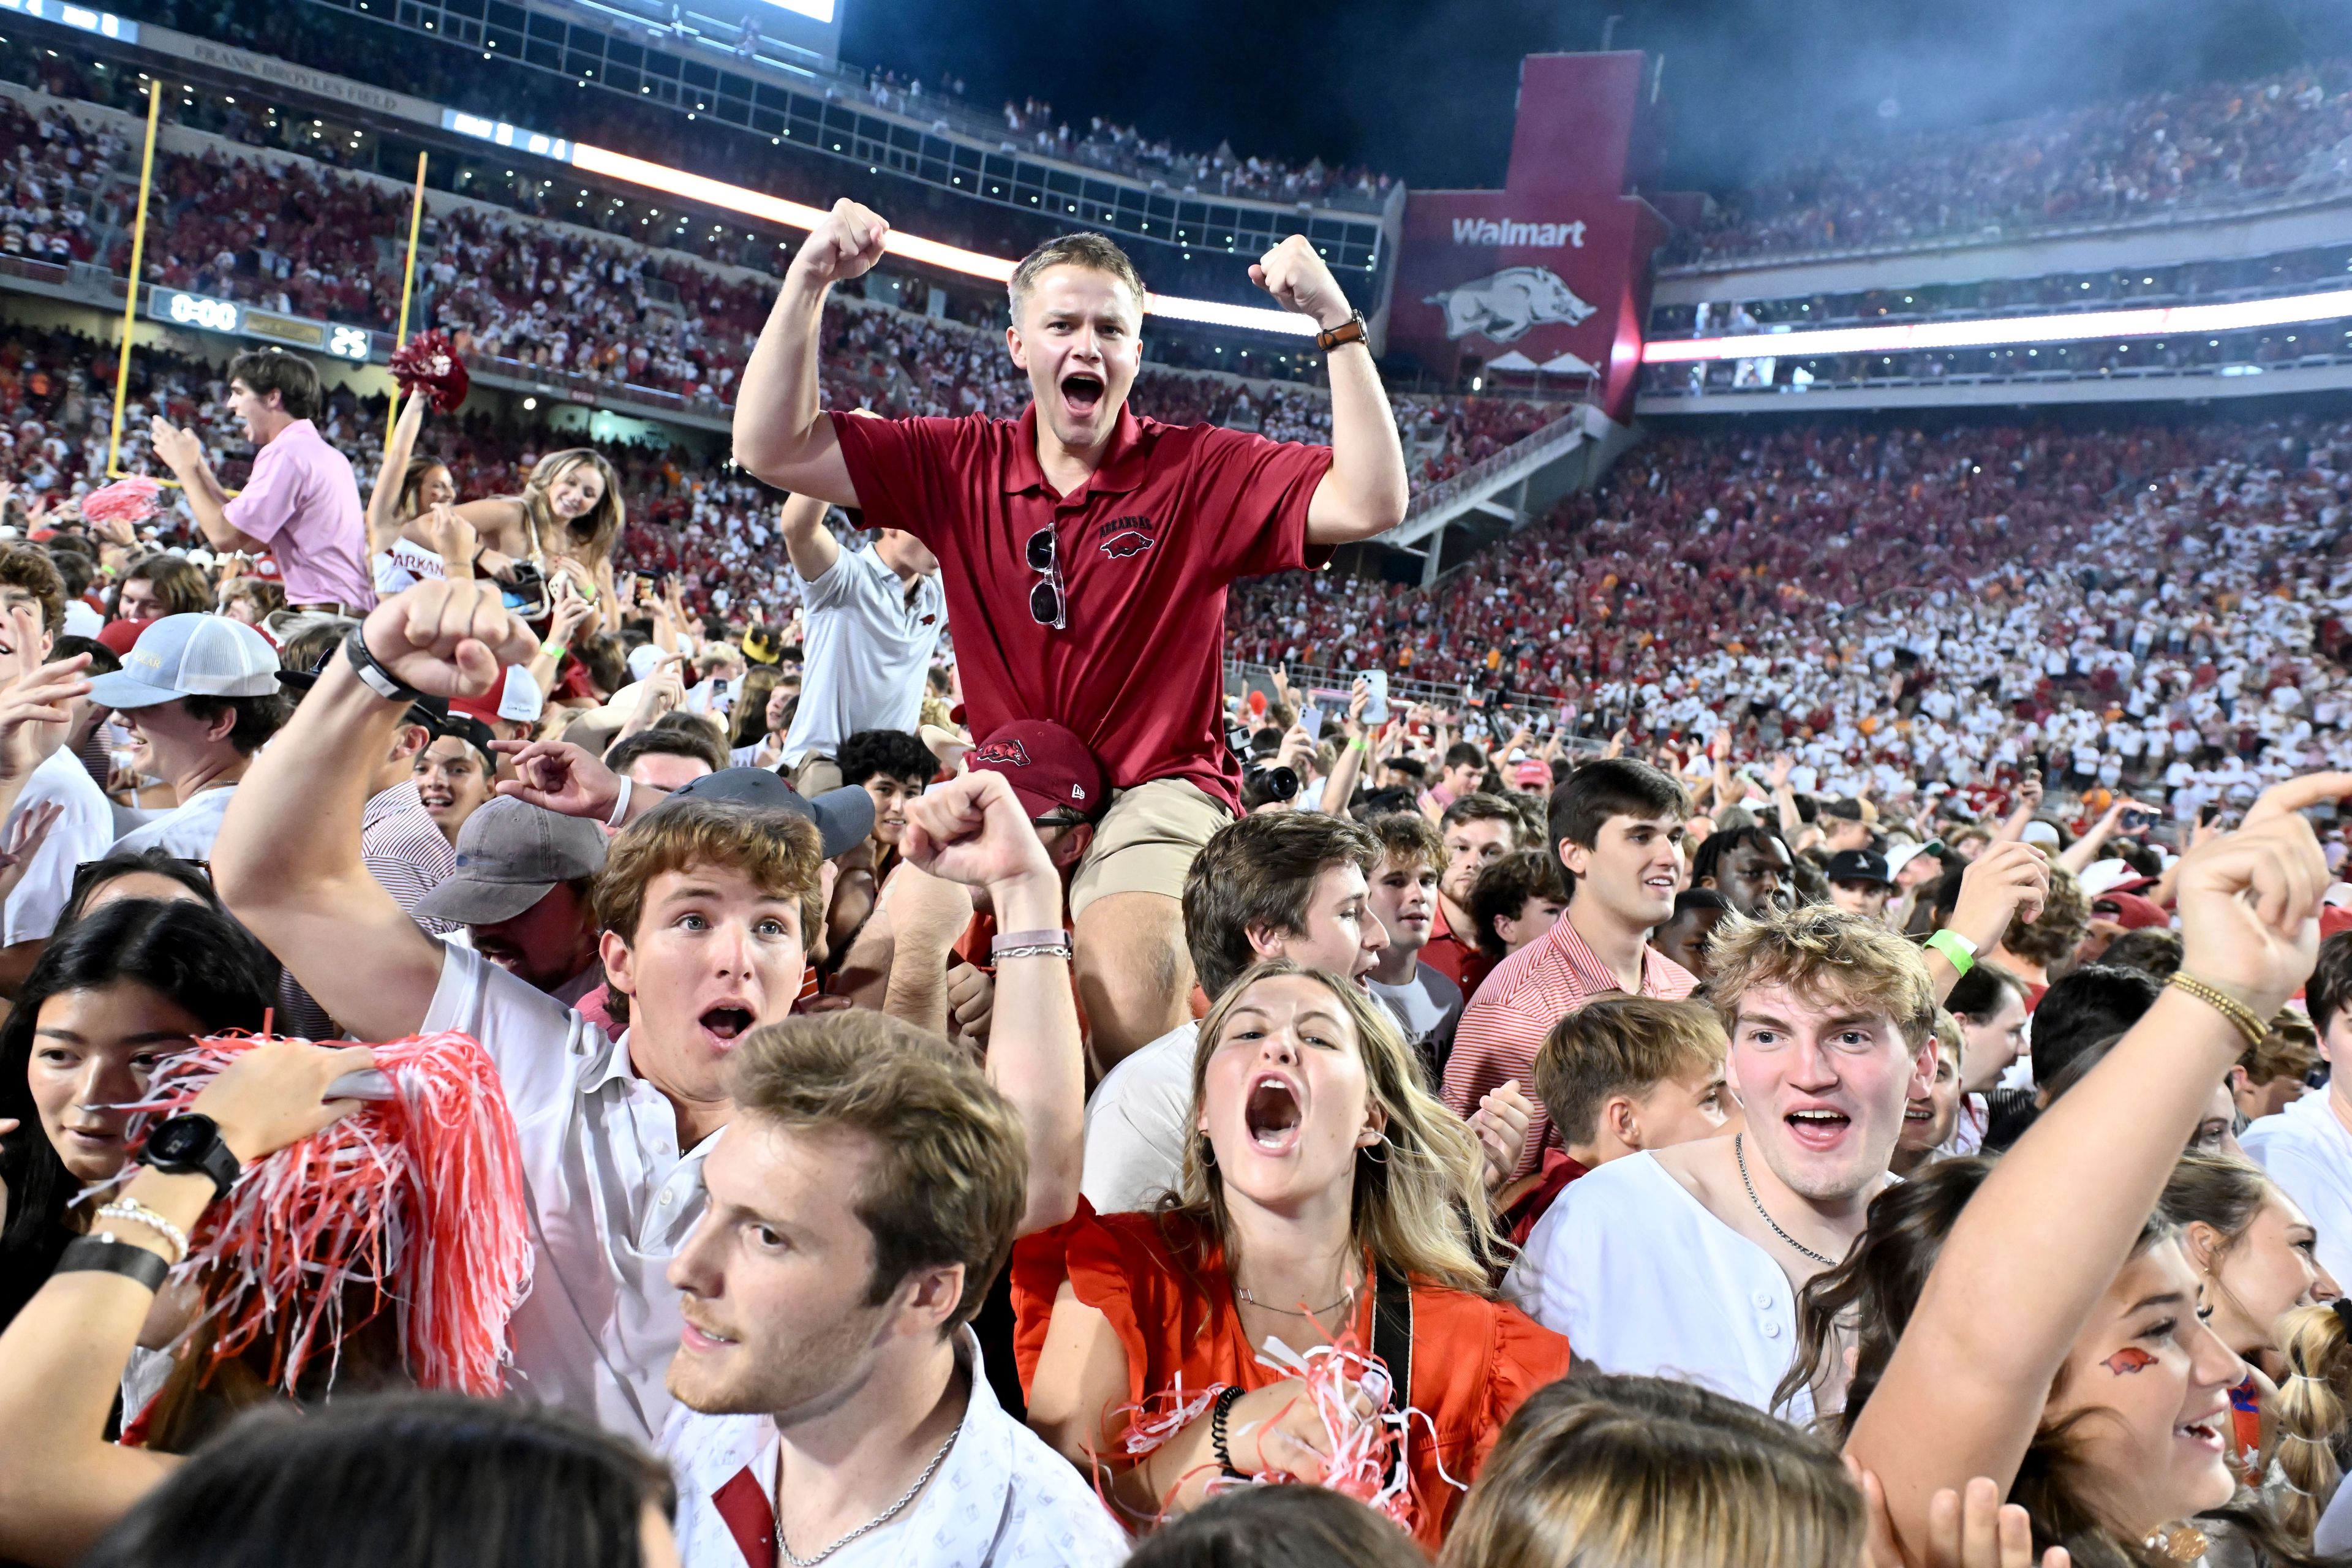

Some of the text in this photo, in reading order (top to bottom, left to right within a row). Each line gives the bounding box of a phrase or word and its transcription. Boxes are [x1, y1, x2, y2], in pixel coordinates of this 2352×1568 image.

[194, 44, 397, 110] FRANK BROYLES FIELD
[1452, 217, 1587, 248] Walmart
[330, 326, 368, 358] 25
[1099, 515, 1153, 539] ARKANSAS
